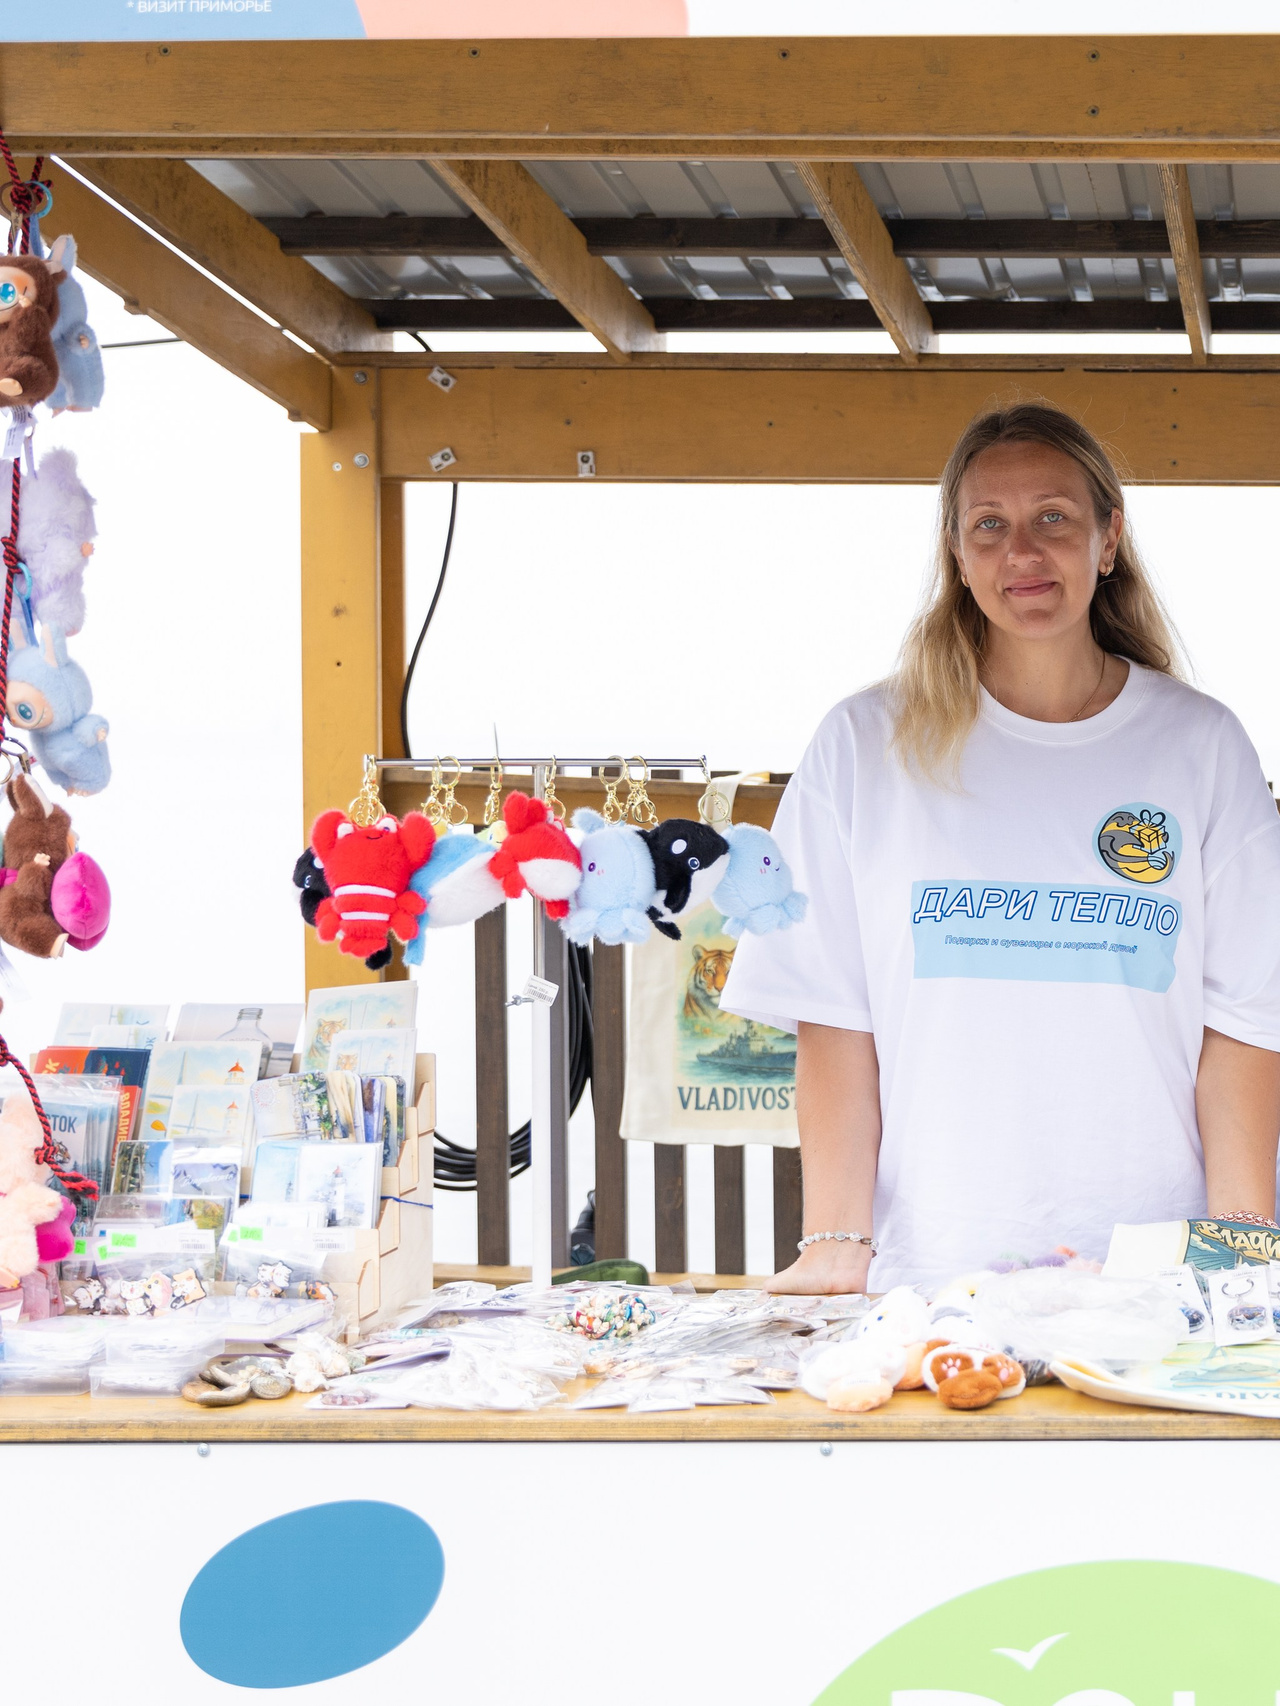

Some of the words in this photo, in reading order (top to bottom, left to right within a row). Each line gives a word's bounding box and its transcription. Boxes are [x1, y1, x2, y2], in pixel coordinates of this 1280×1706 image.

[137, 0, 186, 13] ВИЗИТ
[189, 0, 273, 13] ПРИМОРЬЕ
[913, 886, 1038, 924] ДАРИ
[1049, 890, 1179, 936] ТЕПЛО
[944, 934, 990, 947] Подарки
[991, 937, 999, 946] и
[1000, 937, 1054, 949] сувениры
[1054, 940, 1062, 949] с
[1062, 940, 1108, 952] морской
[1108, 942, 1138, 954] душой
